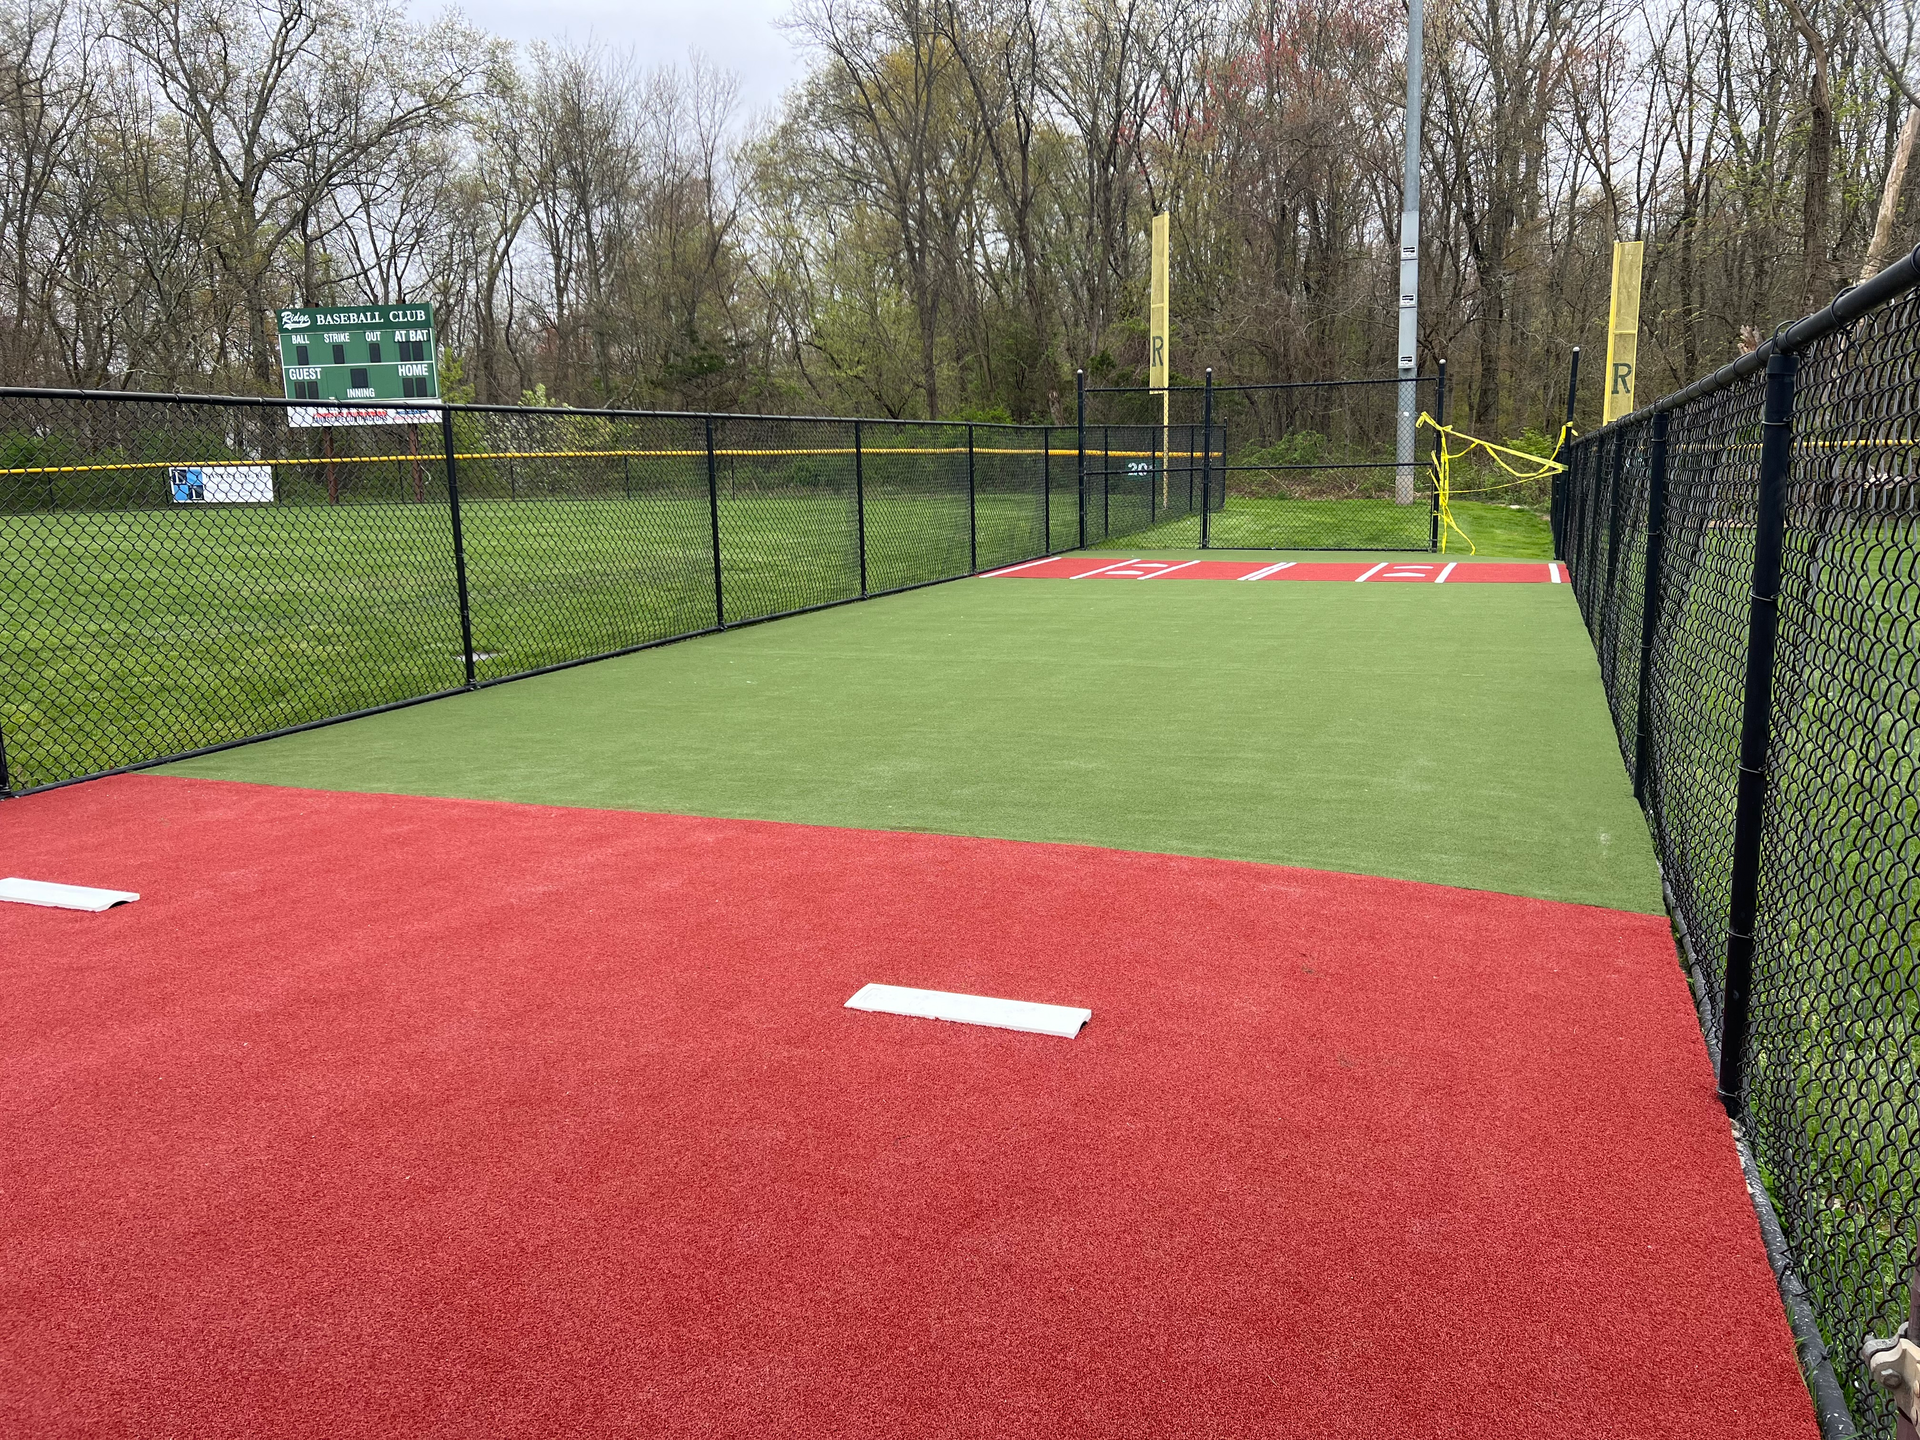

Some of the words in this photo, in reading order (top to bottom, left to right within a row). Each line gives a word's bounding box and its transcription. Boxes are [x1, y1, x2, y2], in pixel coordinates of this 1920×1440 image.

[281, 311, 310, 325] Ridge
[316, 312, 384, 326] BASEBALL
[389, 310, 426, 322] CLUB
[292, 335, 310, 344] BALL
[324, 333, 350, 343] STRIKE
[365, 332, 381, 341] OUT
[395, 331, 407, 342] AT
[409, 330, 428, 341] BAT
[1152, 335, 1164, 367] R
[289, 368, 322, 380] GUEST
[398, 364, 428, 376] HOME
[1611, 363, 1632, 394] R
[347, 388, 375, 398] INNING
